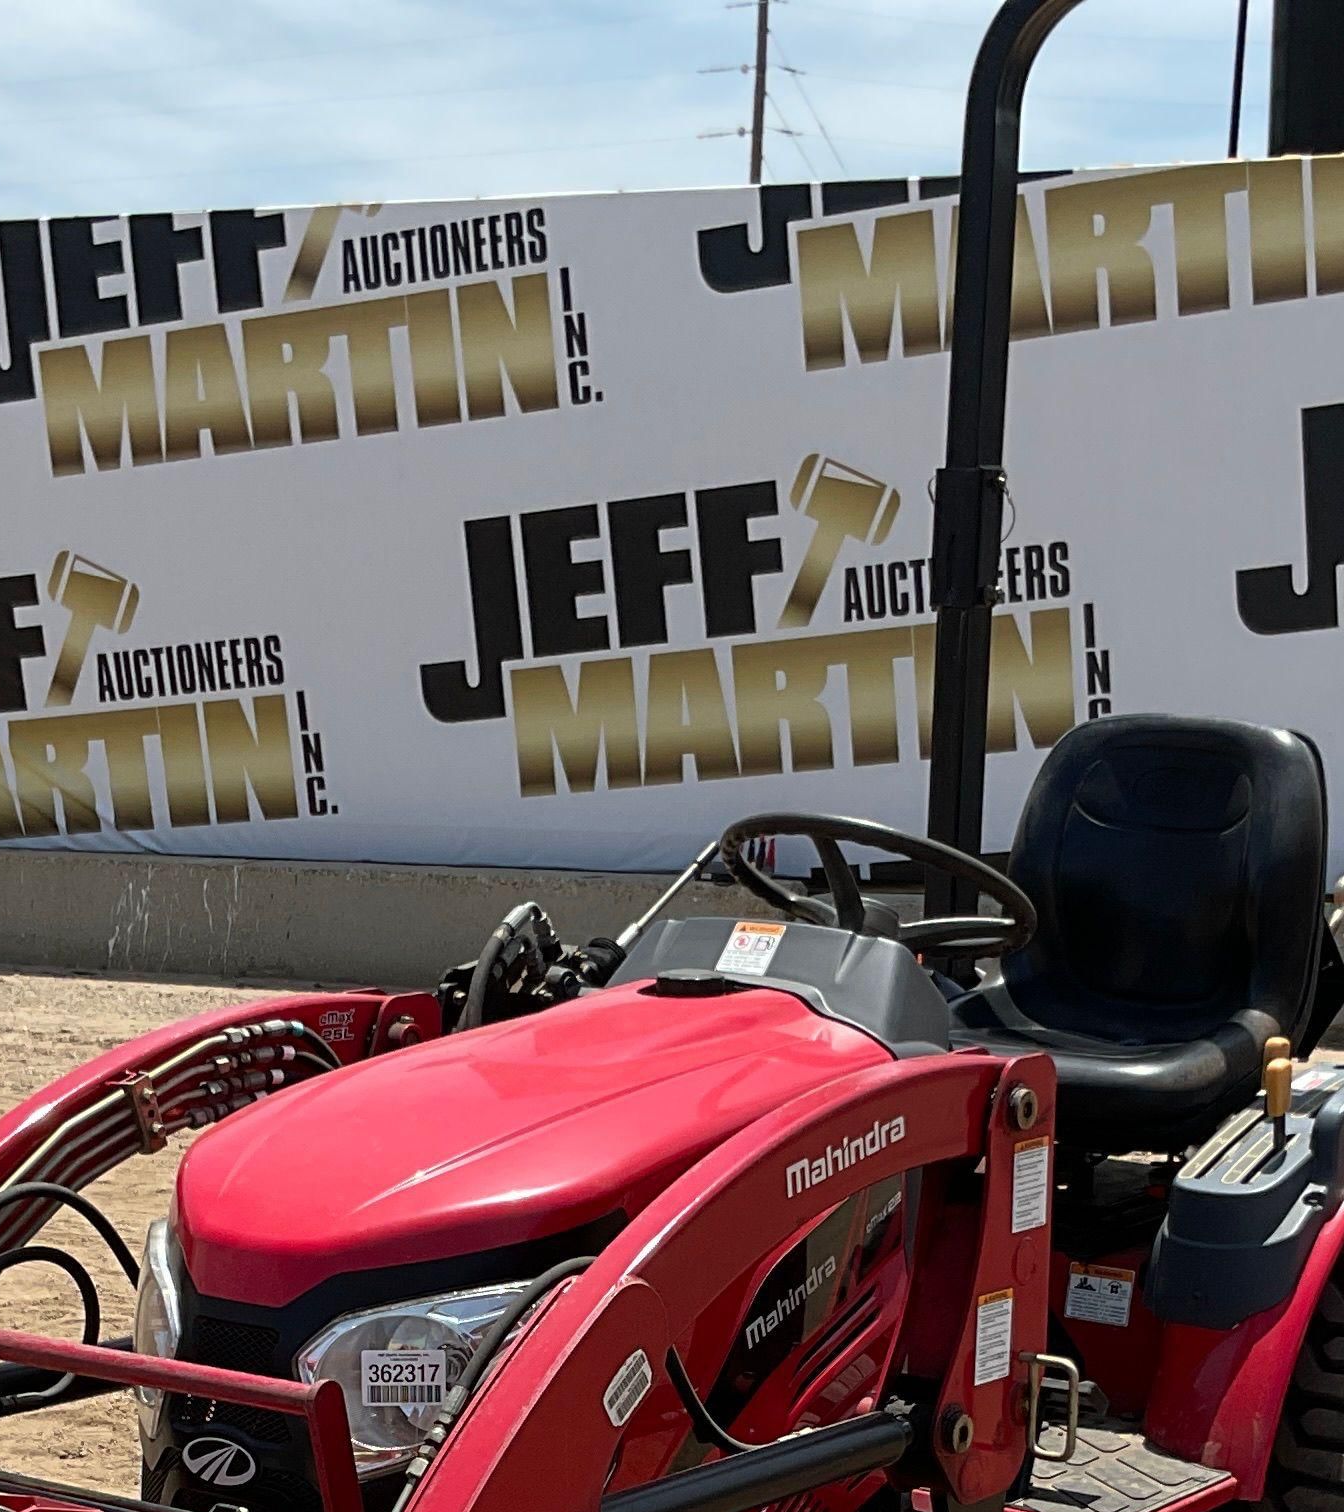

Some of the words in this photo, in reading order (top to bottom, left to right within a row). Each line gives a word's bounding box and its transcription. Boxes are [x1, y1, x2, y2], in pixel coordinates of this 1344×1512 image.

[342, 208, 548, 294] AUCTIONEERS
[39, 272, 560, 478] MARTIN
[559, 266, 603, 405] INC.
[419, 480, 784, 723] JEFF
[844, 541, 1071, 623] AUCTERS
[97, 634, 285, 703] AUCTIONEERS
[296, 690, 339, 816] INC.
[785, 1115, 906, 1199] Mahindra
[745, 1255, 837, 1350] Mahindra
[368, 1363, 441, 1384] 362317
